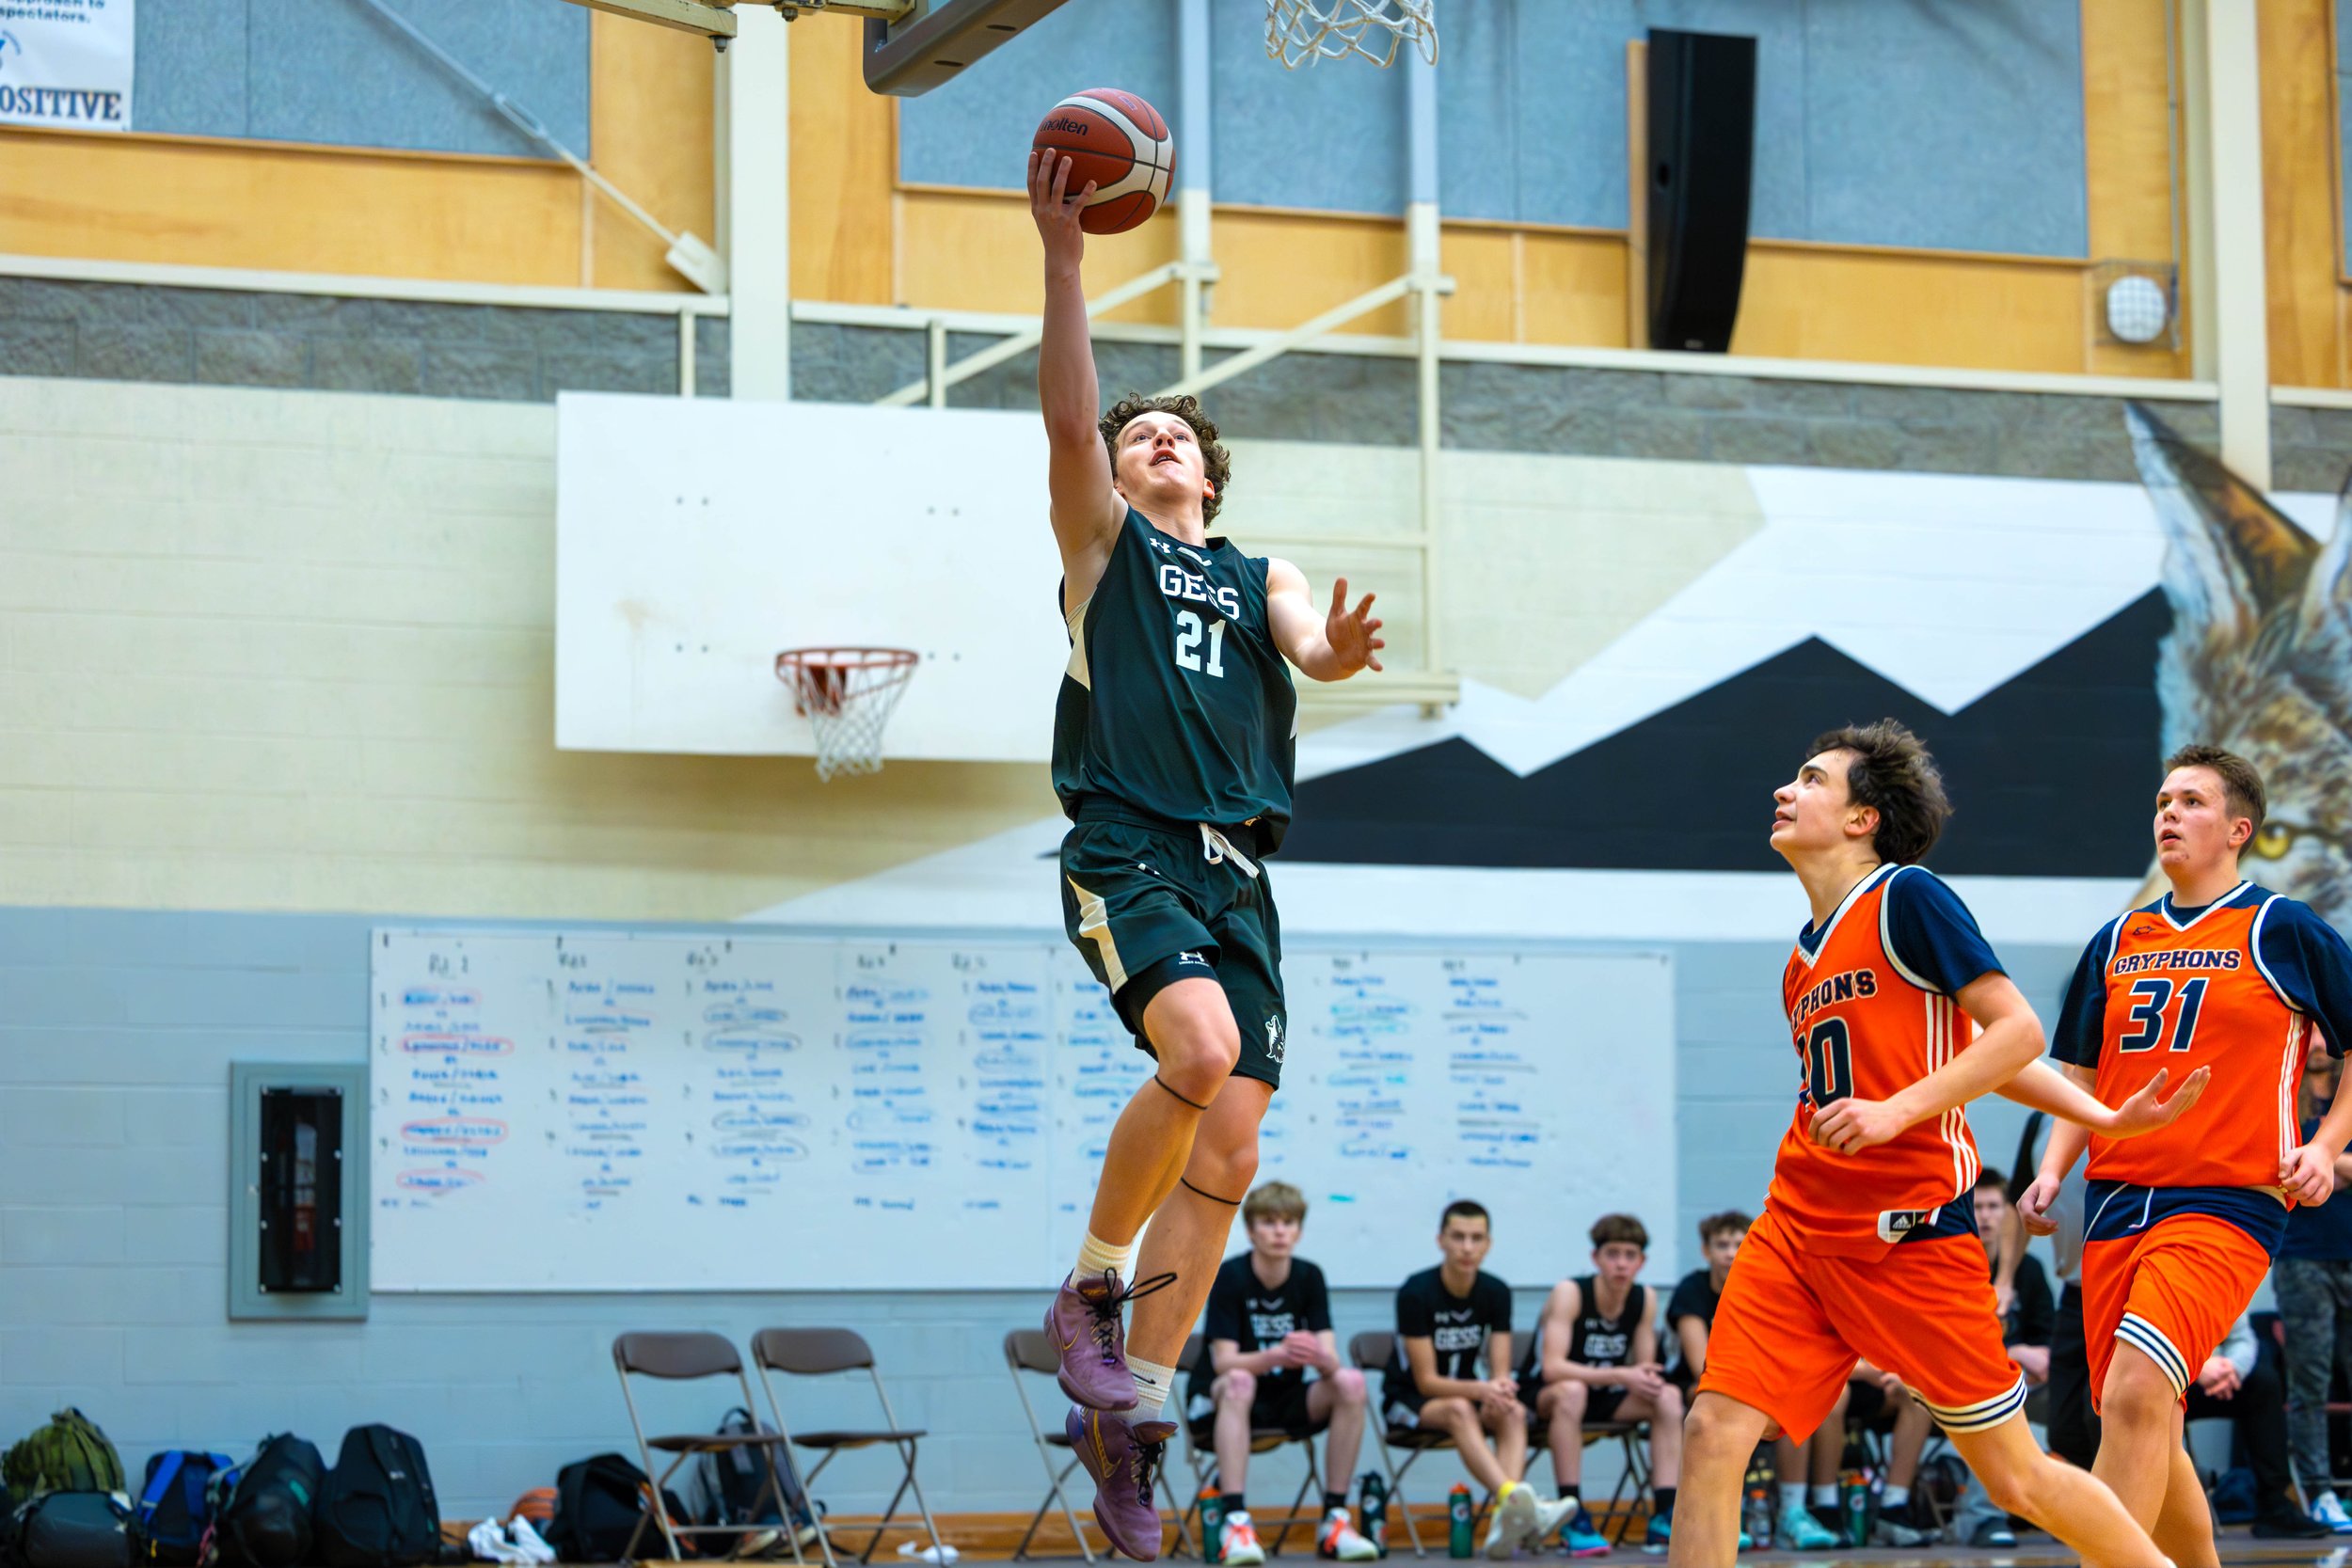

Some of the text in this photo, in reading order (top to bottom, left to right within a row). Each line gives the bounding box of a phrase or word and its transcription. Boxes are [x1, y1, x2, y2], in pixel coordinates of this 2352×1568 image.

[1040, 118, 1089, 136] molten
[1176, 610, 1227, 678] 21
[2113, 948, 2242, 976] GRYPHONS
[2119, 976, 2211, 1053] 31
